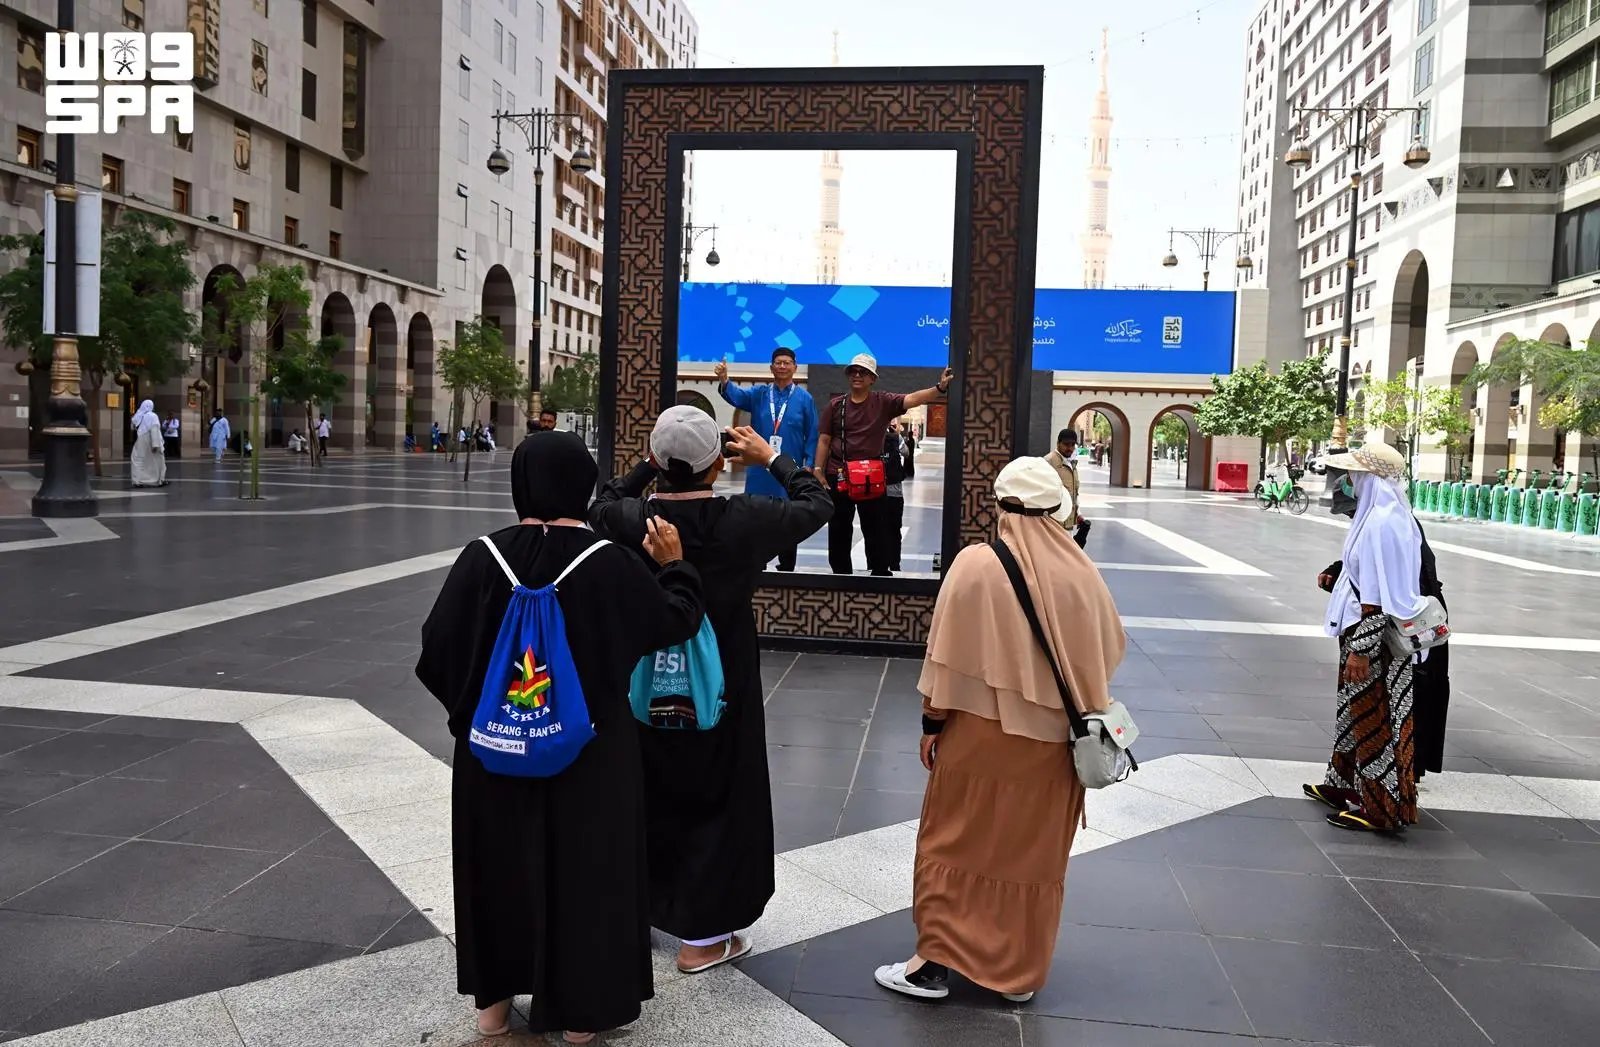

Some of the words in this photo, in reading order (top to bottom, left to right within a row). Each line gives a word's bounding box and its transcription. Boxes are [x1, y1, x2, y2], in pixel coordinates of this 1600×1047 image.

[654, 651, 686, 674] BSI
[501, 703, 551, 722] AZKIA
[487, 721, 522, 737] SERANG
